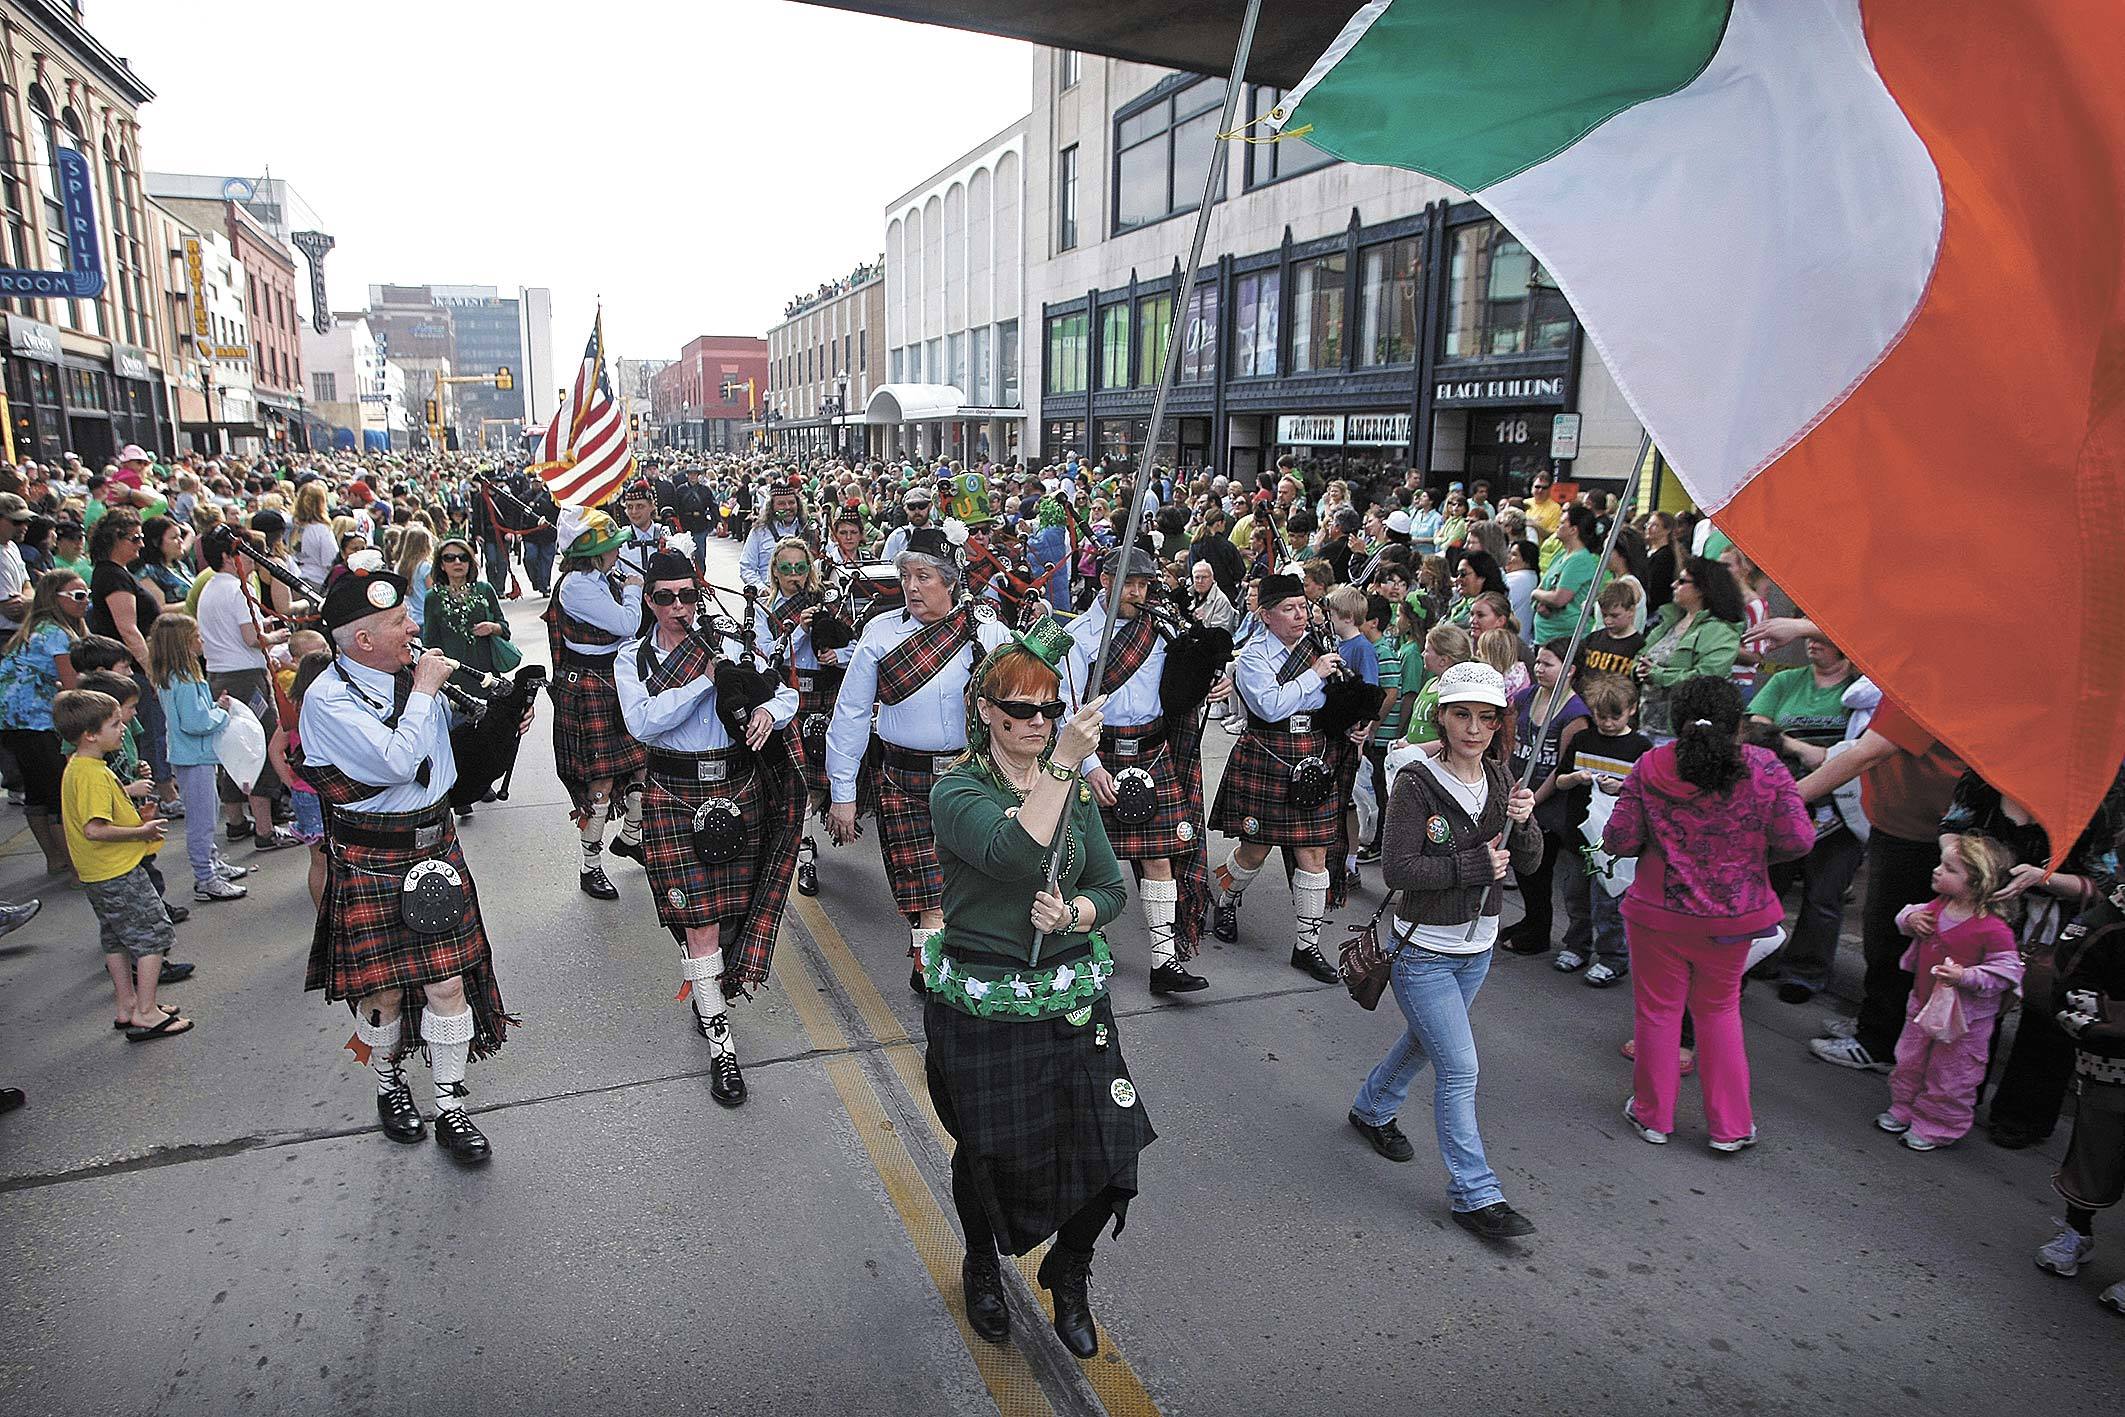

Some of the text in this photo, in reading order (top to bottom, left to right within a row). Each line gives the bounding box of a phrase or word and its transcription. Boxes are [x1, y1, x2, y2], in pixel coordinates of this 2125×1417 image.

[67, 161, 91, 268] SPIRIT
[298, 234, 332, 248] HOTEL
[0, 275, 70, 293] ROOM
[186, 239, 209, 337] ROOTERS
[1436, 377, 1564, 400] BLACK BUILDING
[1288, 418, 1335, 441] FRONTIER
[1495, 419, 1529, 444] 118
